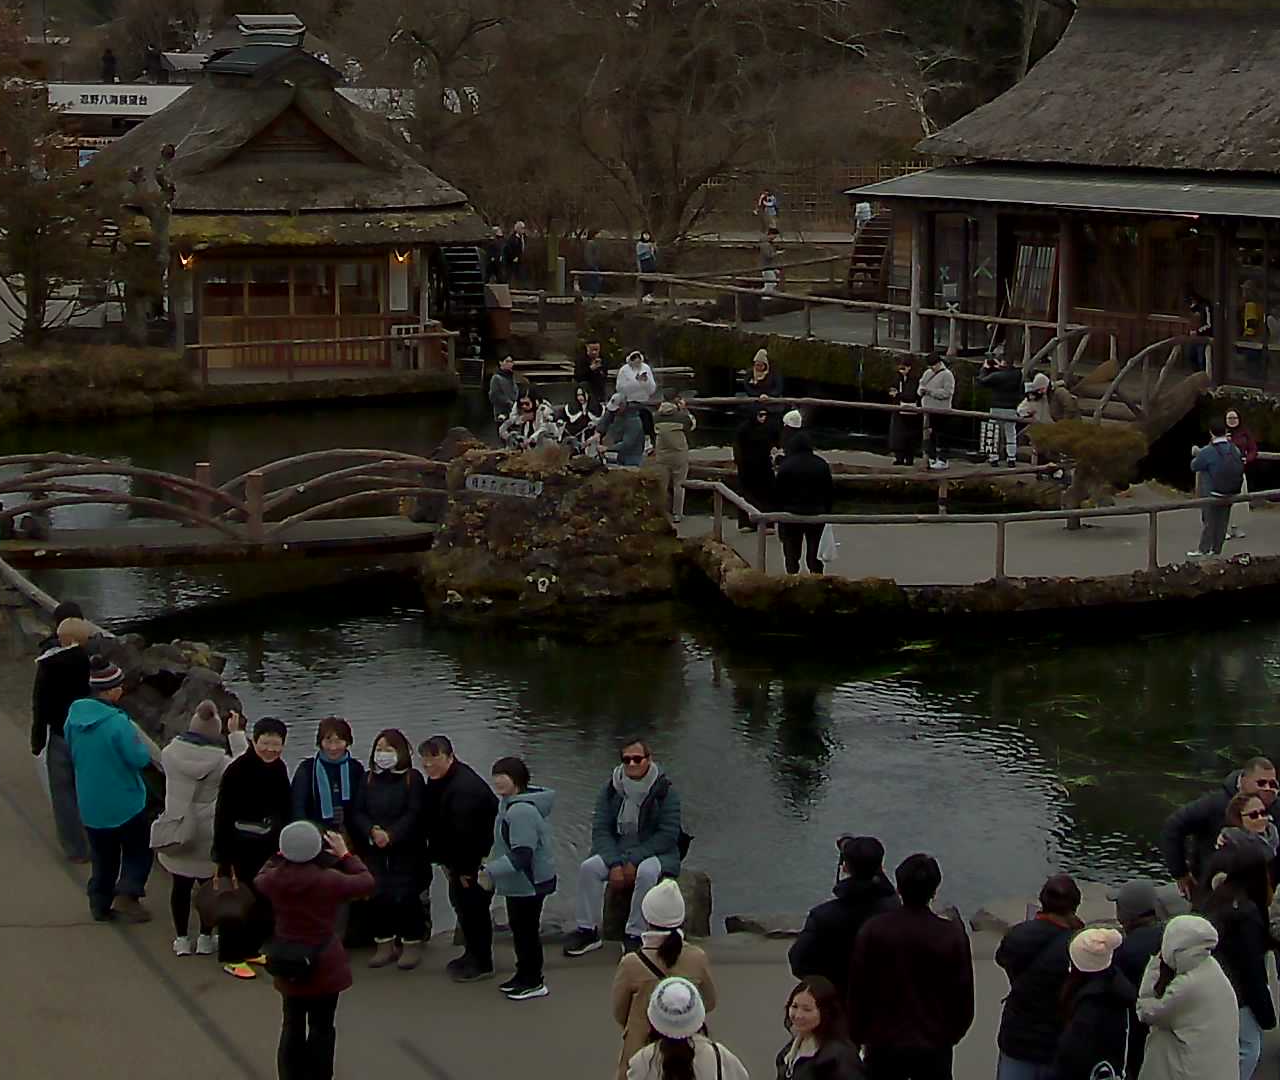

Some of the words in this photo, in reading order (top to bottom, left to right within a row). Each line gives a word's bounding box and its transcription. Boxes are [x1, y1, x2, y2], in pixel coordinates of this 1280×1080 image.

[79, 94, 148, 106] 忍野八海展望台
